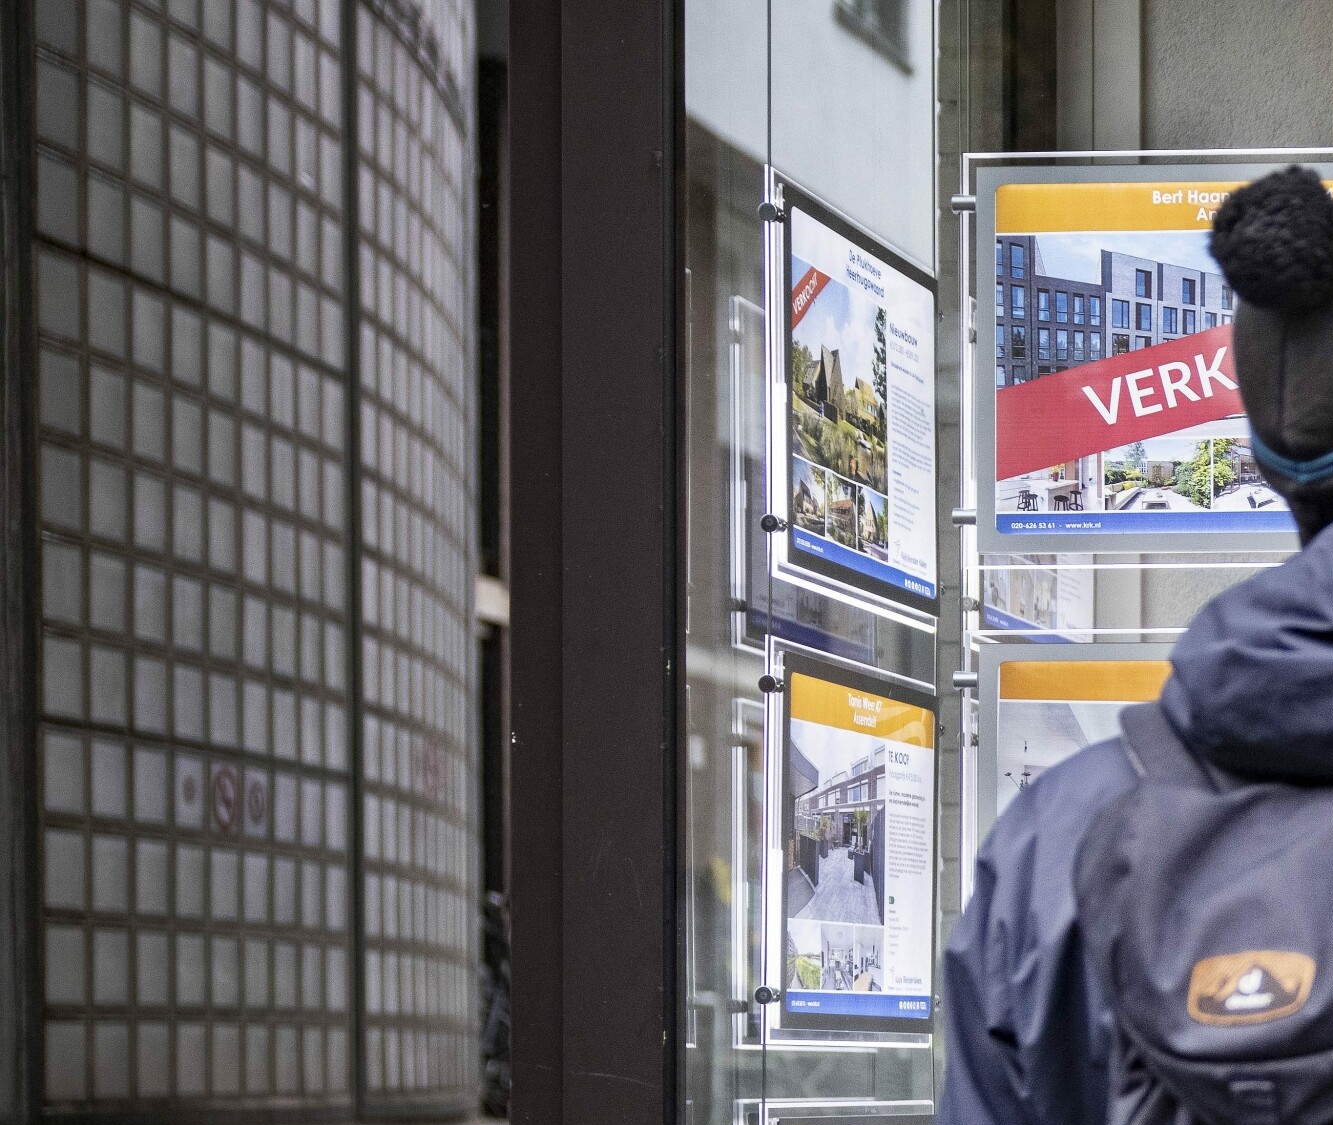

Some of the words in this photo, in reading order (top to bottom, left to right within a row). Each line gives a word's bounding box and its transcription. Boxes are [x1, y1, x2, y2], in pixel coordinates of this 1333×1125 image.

[1152, 190, 1183, 204] Bert
[1188, 190, 1230, 203] Haan
[792, 272, 819, 315] VERKOCHT
[1081, 346, 1239, 425] VERK
